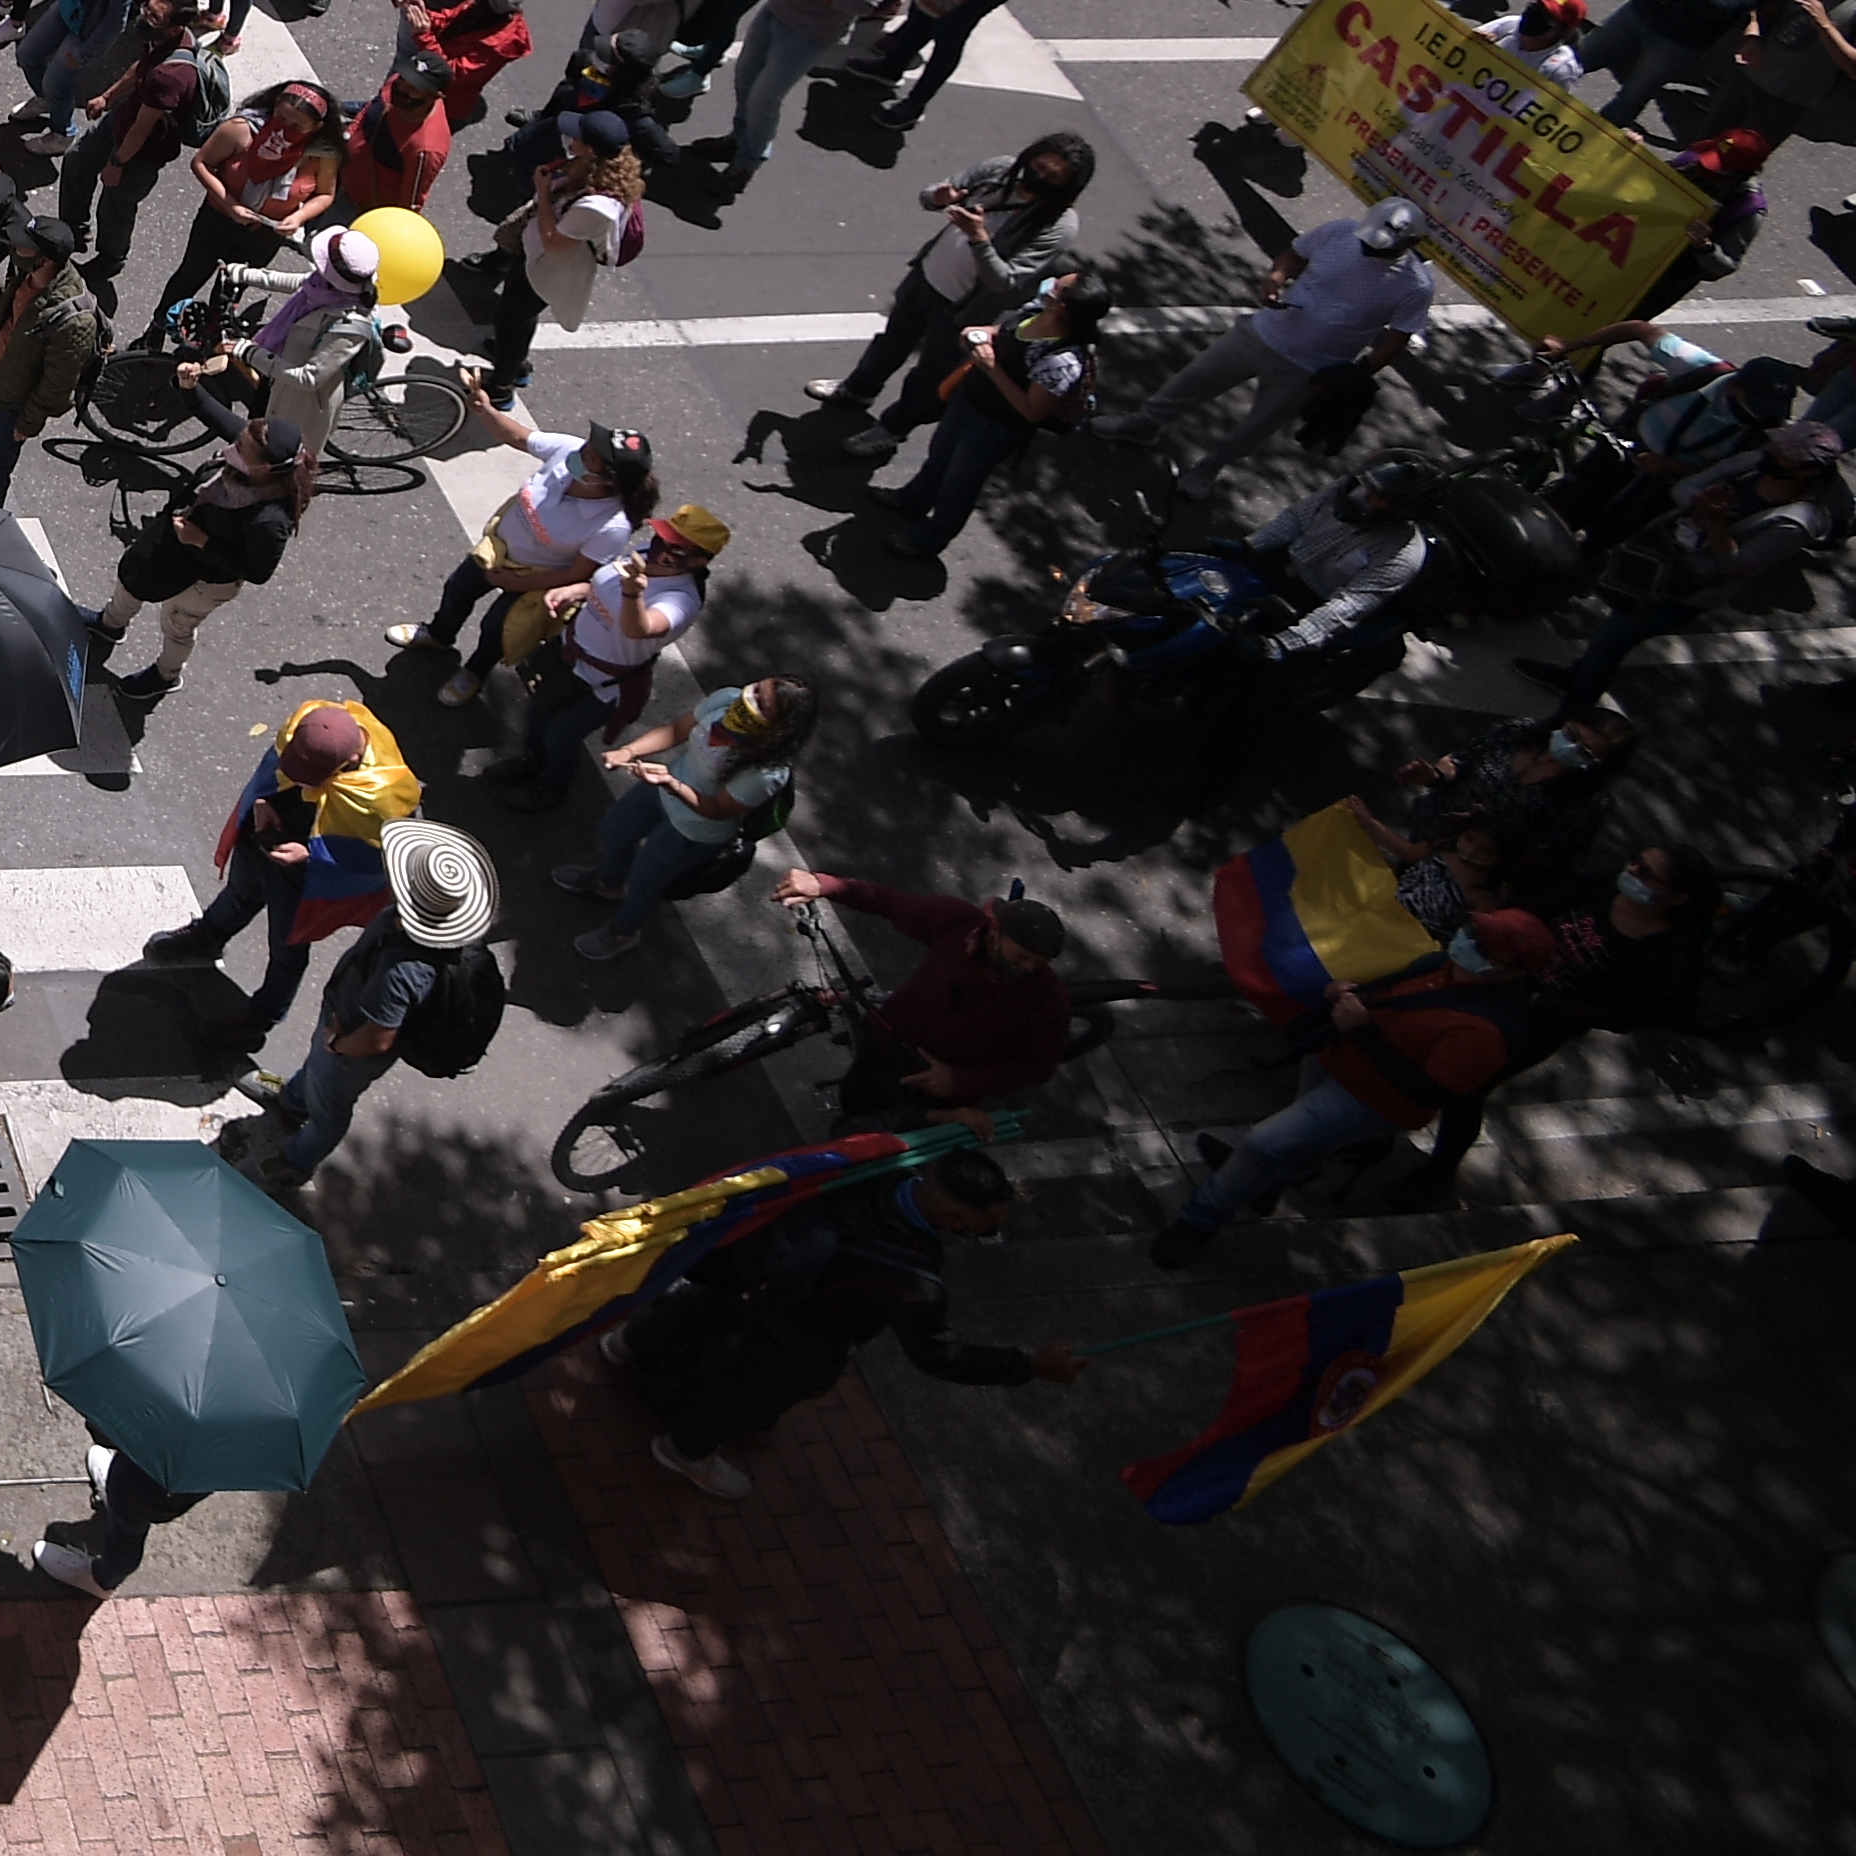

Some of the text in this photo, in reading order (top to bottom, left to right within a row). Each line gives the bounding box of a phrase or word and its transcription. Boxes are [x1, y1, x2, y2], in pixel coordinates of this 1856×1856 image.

[1334, 0, 1636, 270] CASTILLA
[1414, 22, 1585, 155] I.E.D. COLEGIO
[1345, 110, 1437, 195] PRESENTE
[1472, 215, 1578, 307] PRESENTE
